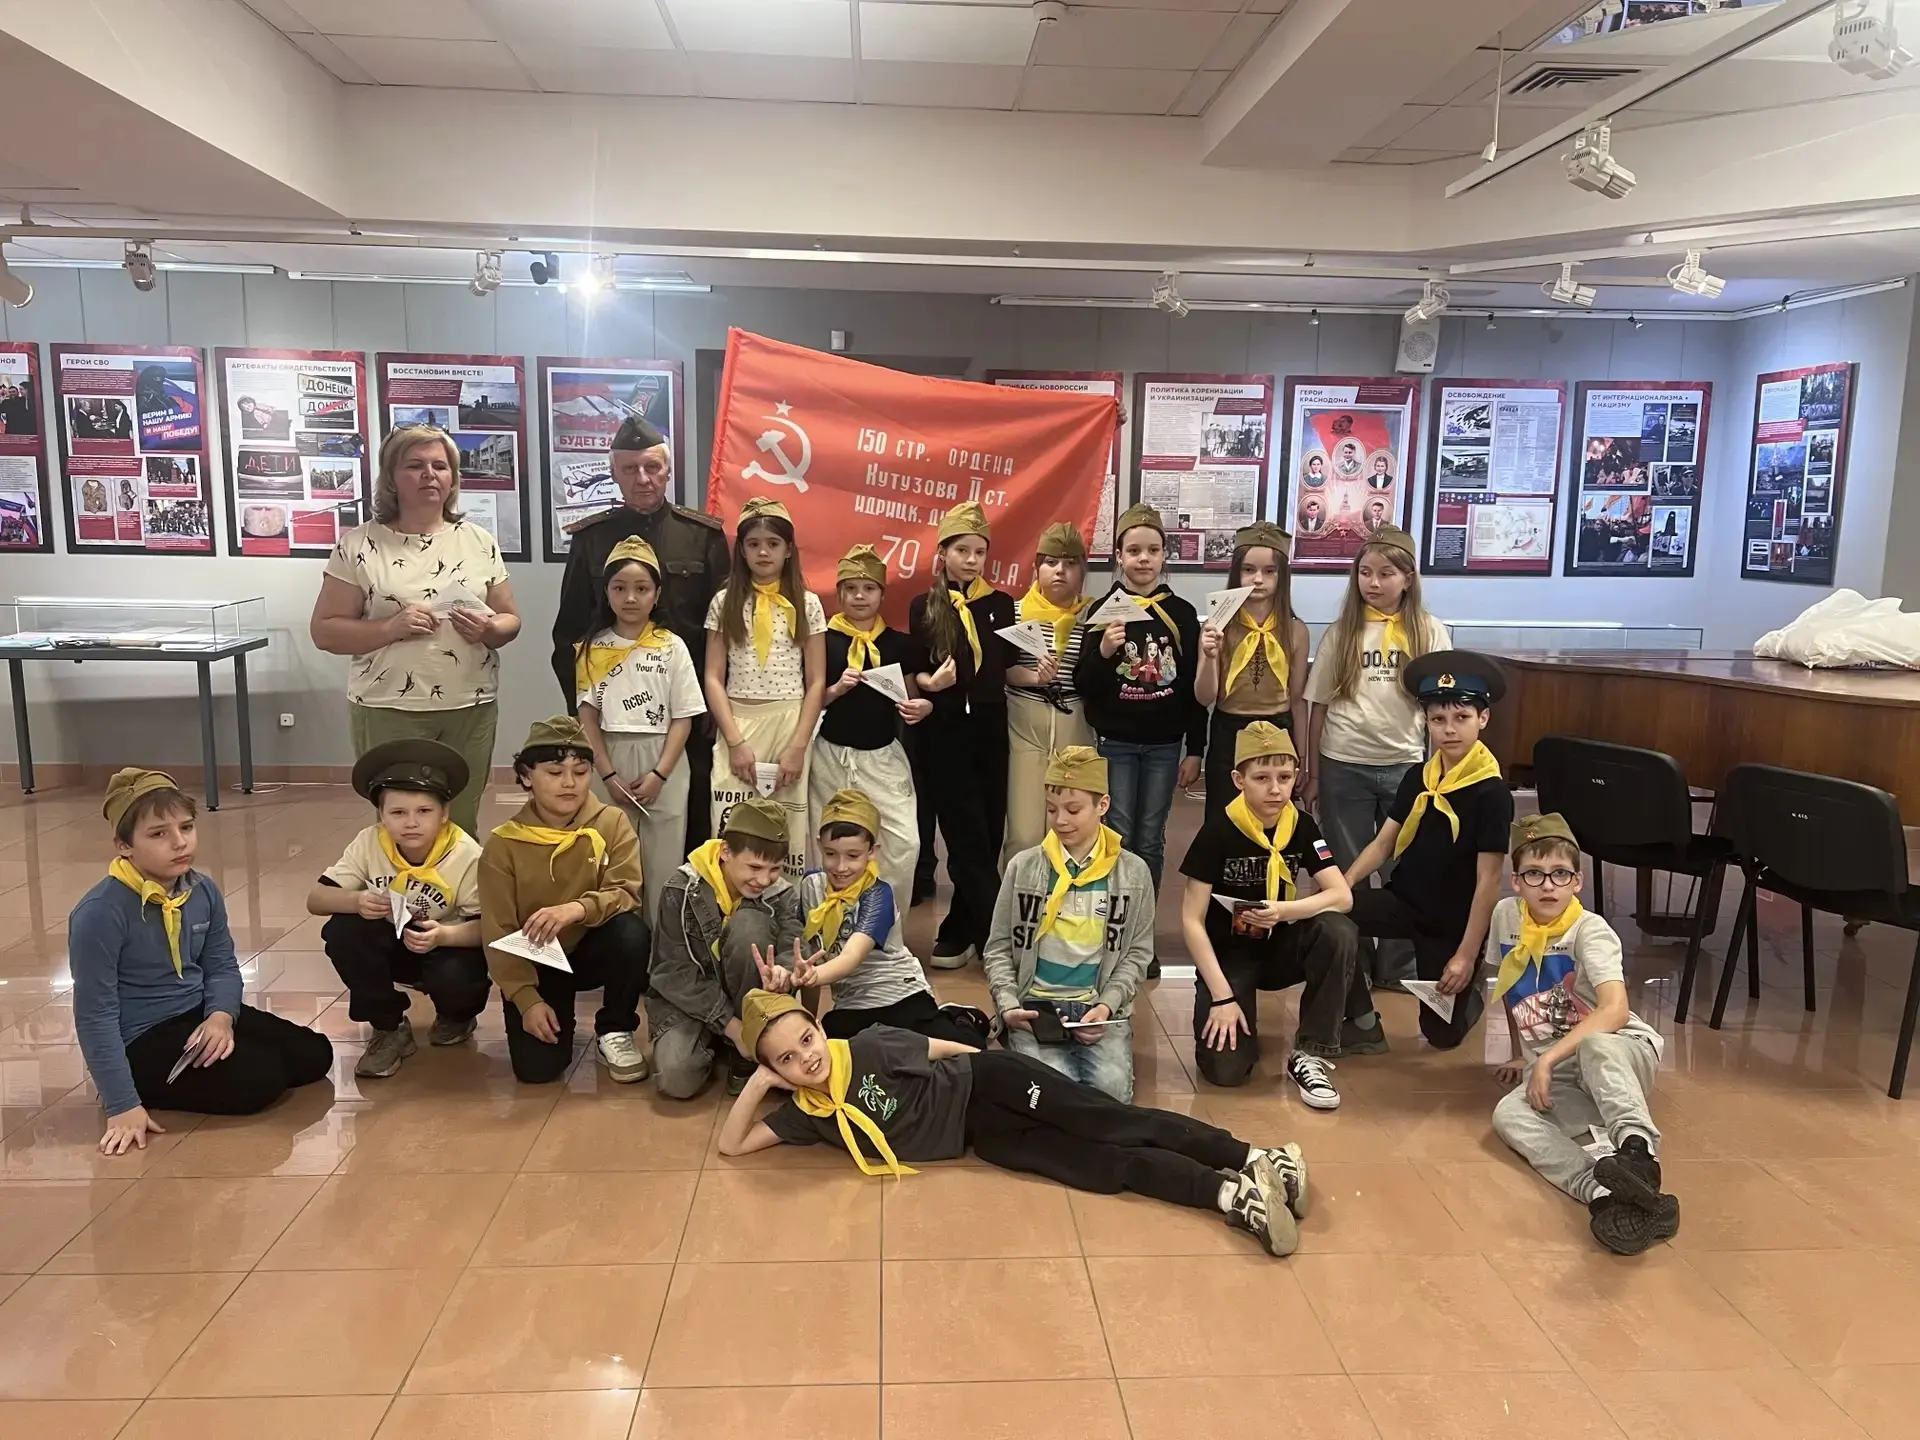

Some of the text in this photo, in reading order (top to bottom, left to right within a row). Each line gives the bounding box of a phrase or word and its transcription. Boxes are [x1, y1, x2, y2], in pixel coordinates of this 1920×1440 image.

[66, 358, 92, 366] ГЕРОИ
[231, 363, 353, 373] АРТЕФАКТЫ СВИДЕТЕЛЬСТВУЮТ
[393, 368, 484, 377] ВОССТАНОВИМ ВМЕСТЕ!
[305, 379, 350, 395] ДОНЕЦК
[1191, 388, 1244, 396] КОРЕНИЗАЦИИ
[1447, 392, 1506, 400] ОСВОБОЖДЕНИЕ
[1602, 394, 1684, 402] ИНТЕРНАЦИОНАЛИЗМА
[142, 410, 167, 420] ВЕРИМ
[142, 417, 164, 426] НАШУ
[153, 424, 172, 433] НАШУ
[163, 425, 199, 439] ПОБЕДУ!
[559, 435, 597, 447] БУДЕТ
[857, 428, 888, 455] 150
[948, 448, 1014, 476] ОРДЕНА
[245, 454, 296, 472] ДЕТИ
[854, 494, 922, 524] ИДРИЦК.
[881, 534, 921, 579] 79
[1029, 1088, 1042, 1110] PUMA
